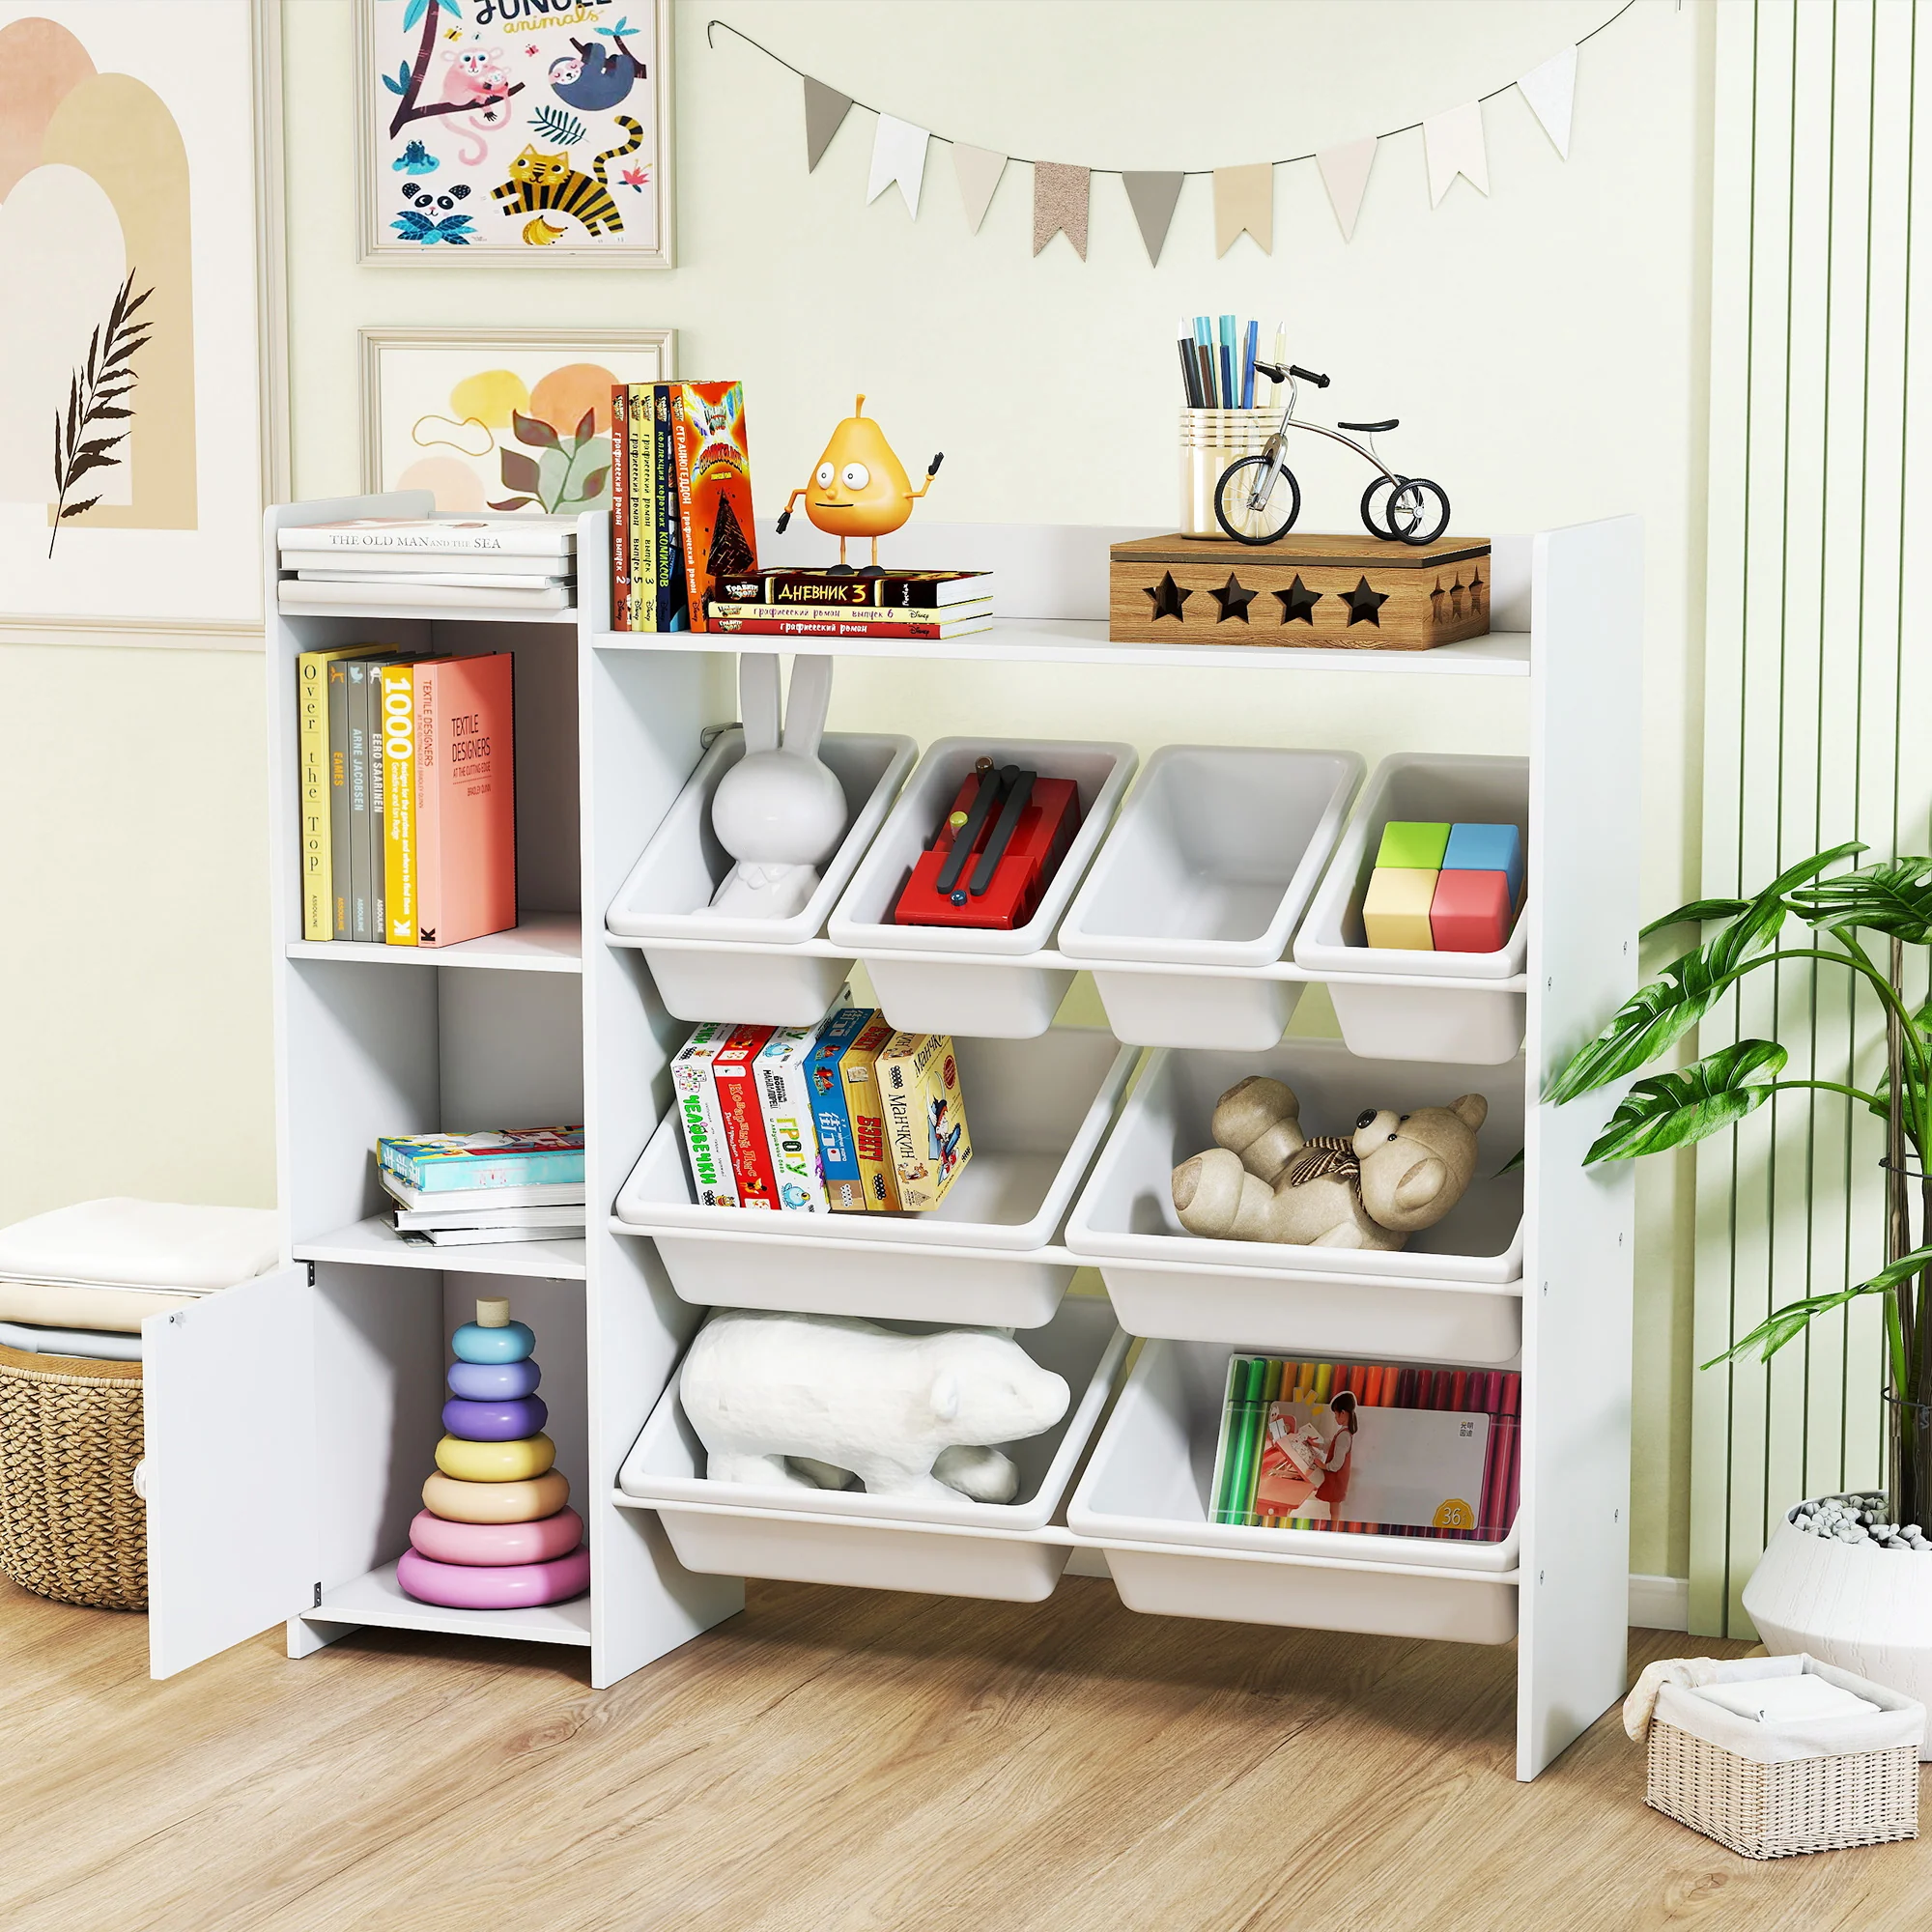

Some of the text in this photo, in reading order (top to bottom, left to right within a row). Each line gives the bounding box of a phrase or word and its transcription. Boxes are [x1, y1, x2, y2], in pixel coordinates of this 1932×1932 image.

[473, 0, 612, 25] JUN
[503, 4, 604, 34] animals
[613, 497, 623, 526] роман
[630, 497, 639, 526] роман
[642, 497, 651, 526] роман
[657, 485, 666, 527] коротких
[676, 426, 692, 504] СТРАННОГЕДДОН
[686, 568, 697, 594] роман
[329, 534, 359, 546] THE
[362, 534, 393, 546] OLD
[397, 536, 429, 547] MAN
[431, 539, 451, 548] AND
[473, 537, 501, 549] SEA
[659, 531, 669, 587] КОМИКСОВ
[616, 576, 626, 584] 2
[779, 583, 867, 603] ДНЕВНИК 3
[813, 610, 840, 619] роман
[887, 609, 894, 618] 6
[839, 624, 867, 635] роман
[908, 609, 929, 621] Disney
[384, 677, 413, 760] 1000
[422, 680, 434, 767] TEXTILE DESIGNERS
[451, 714, 479, 737] TEXTILE
[452, 736, 491, 762] DESIGNERS
[304, 665, 319, 871] Over the Top
[333, 752, 344, 786] EAMES
[353, 728, 364, 811] ARNE JACOBSEN
[373, 733, 384, 812] EERO SAARINEN
[913, 1034, 946, 1078] Манчк
[683, 1094, 718, 1184] ЧЕЛОВЕЧКИ
[857, 1115, 884, 1162] БЭНГ!
[889, 1094, 916, 1159] Манчкин
[777, 1118, 809, 1178] ГРОГУ
[1442, 1507, 1462, 1525] 36
